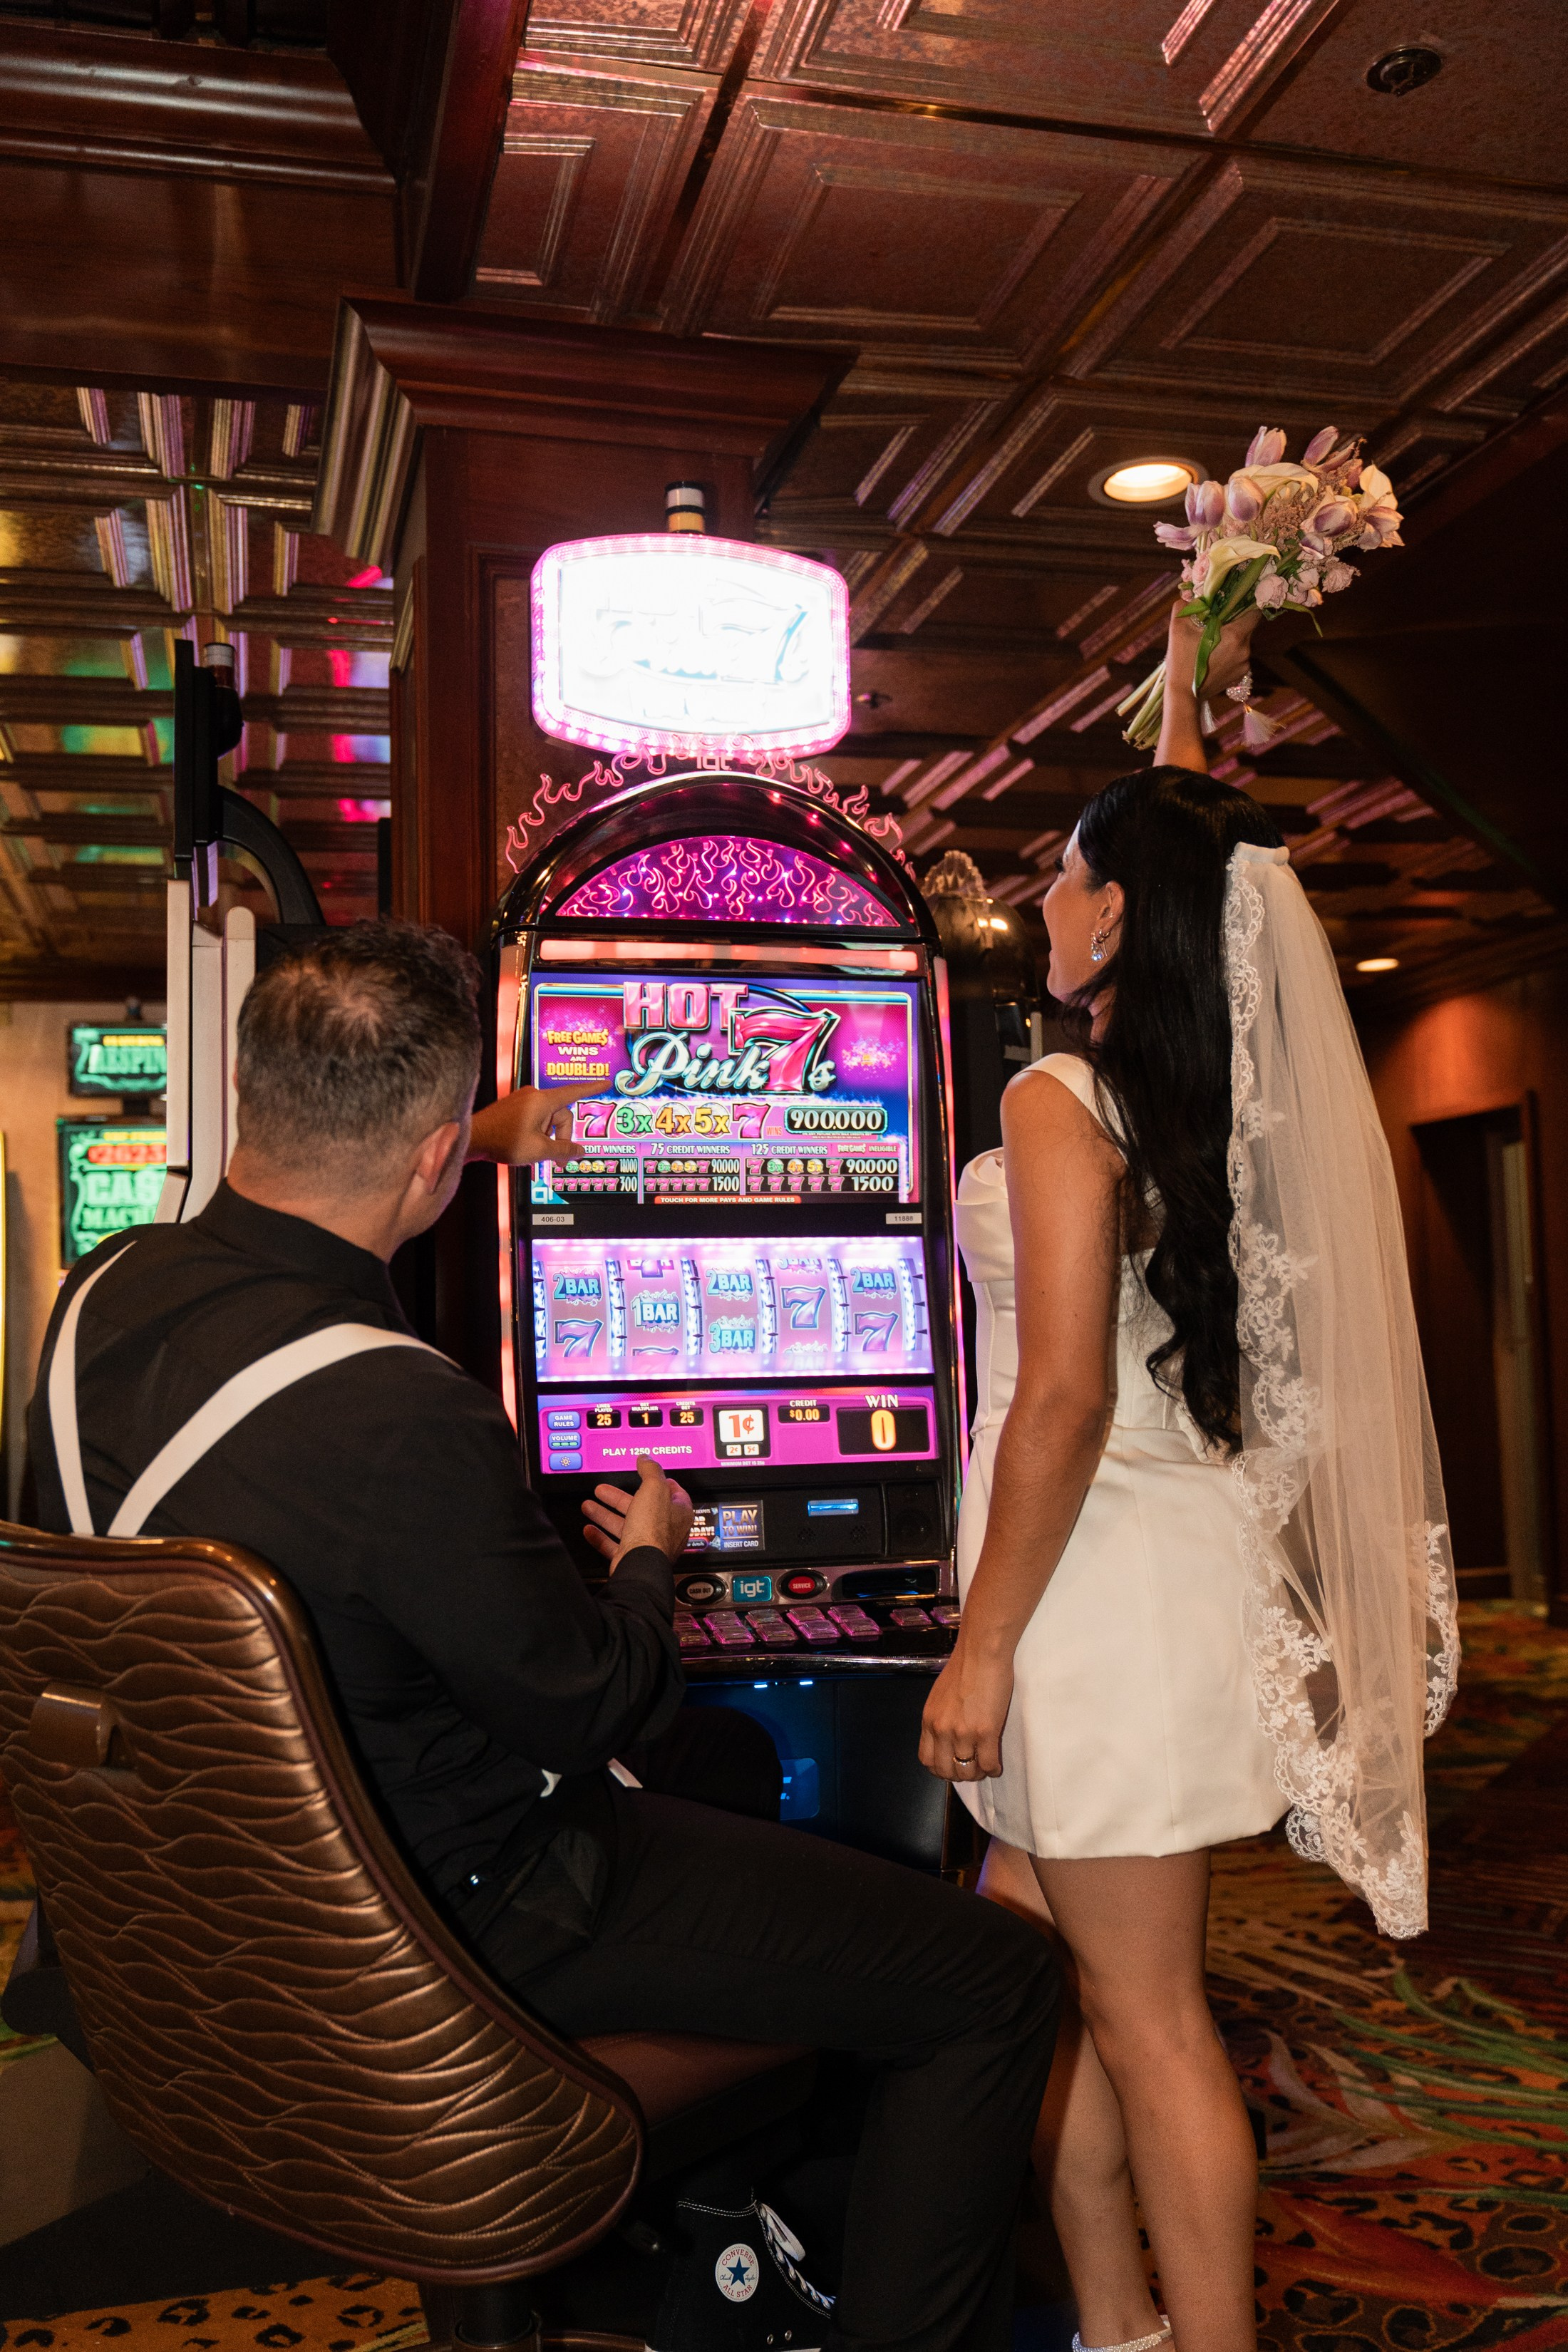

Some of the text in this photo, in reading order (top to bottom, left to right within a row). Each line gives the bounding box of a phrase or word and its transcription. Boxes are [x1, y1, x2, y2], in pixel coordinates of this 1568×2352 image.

[623, 981, 748, 1031] HOT
[547, 1030, 572, 1046] FREE
[557, 1046, 599, 1056] WINS
[547, 1062, 610, 1077] DOUBLED!
[614, 1031, 770, 1098] Pink
[766, 1126, 783, 1136] WINS
[583, 1145, 636, 1154] EDIT WINNERS
[651, 1143, 731, 1155] 75 CREDIT WINNERS
[751, 1143, 827, 1155] 125 CREDIT WINNERS
[86, 1171, 165, 1207] CAS
[619, 1176, 637, 1192] 300
[712, 1176, 740, 1191] 1500
[852, 1176, 894, 1192] 1500
[865, 1394, 899, 1408] WIN
[597, 1413, 612, 1425] 25
[641, 1413, 649, 1425] 1
[679, 1411, 695, 1424] 25
[789, 1408, 820, 1421] $0.00
[728, 1414, 755, 1438] 1¢
[870, 1409, 897, 1450] 0
[602, 1448, 626, 1456] PLAY
[652, 1446, 692, 1455] CREDITS
[693, 1516, 706, 1525] OR
[722, 1510, 758, 1525] PLAY
[689, 1526, 715, 1537] ODAY!
[723, 1525, 758, 1535] TO WIN!
[740, 1580, 765, 1597] igt
[722, 2249, 755, 2266] CONVERSE
[723, 2284, 752, 2298] ALL STAR
